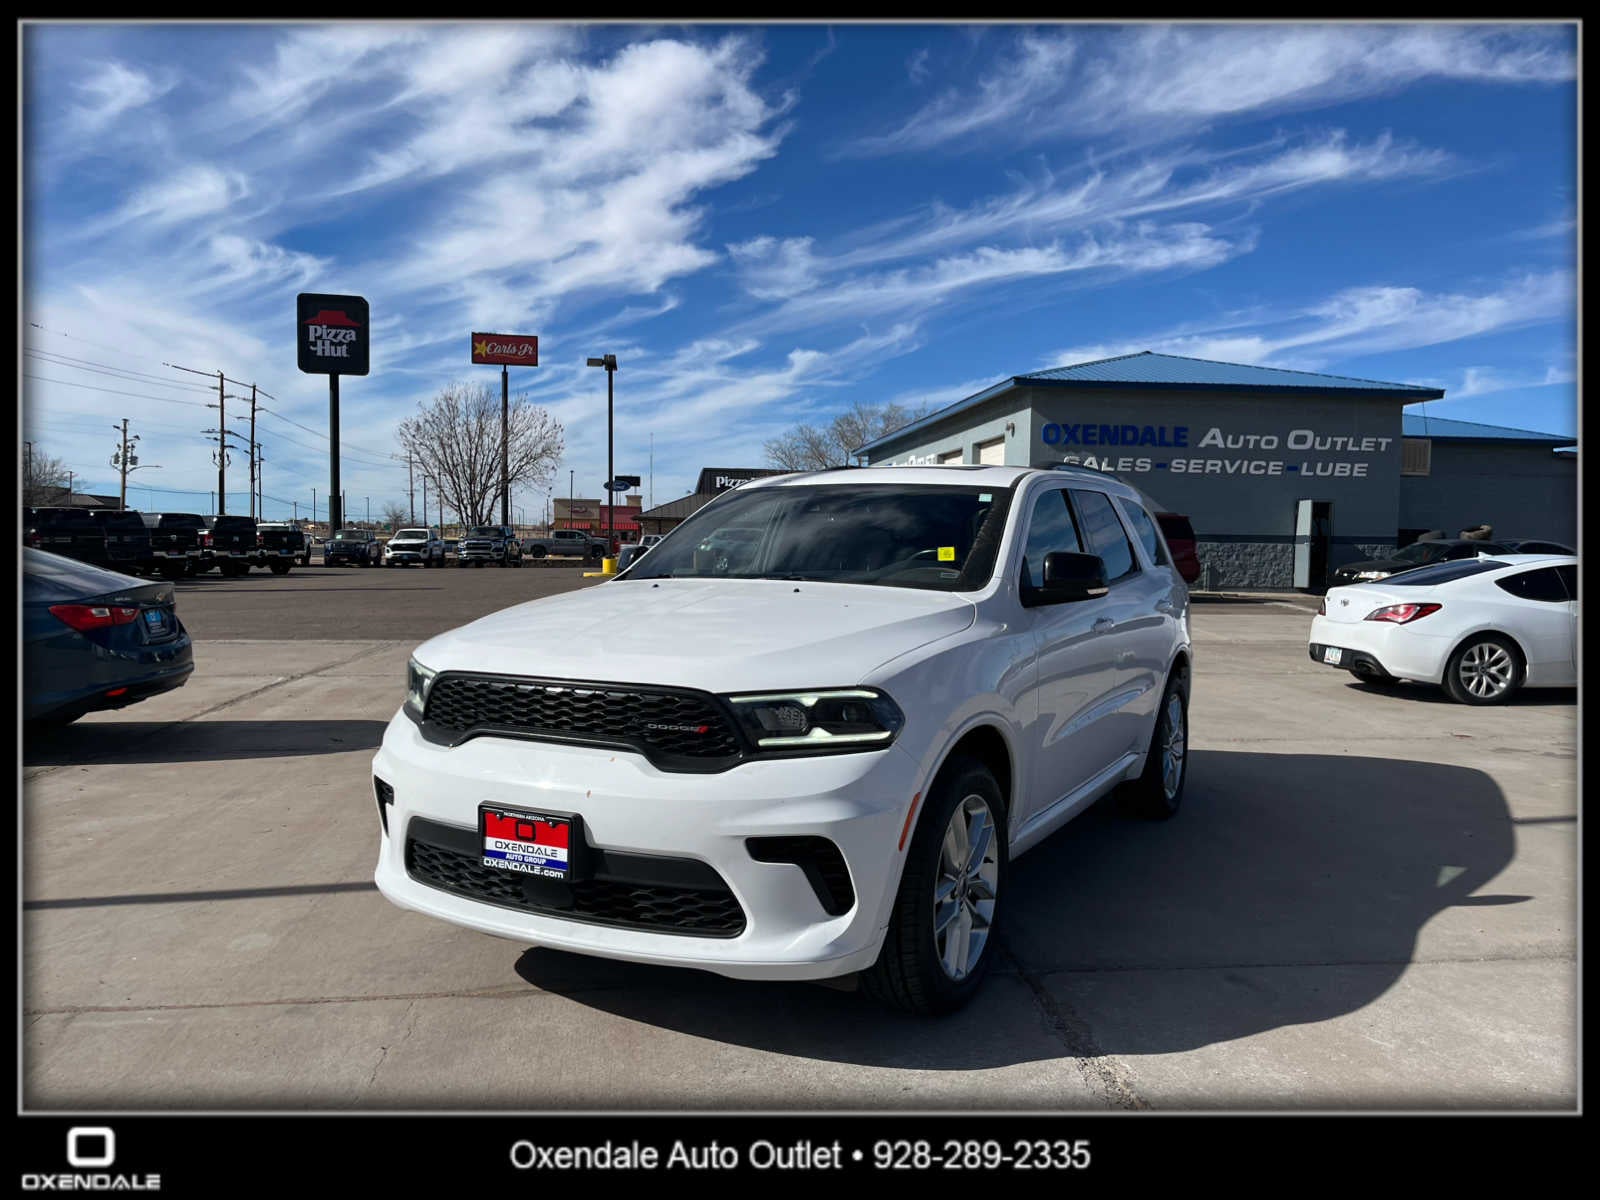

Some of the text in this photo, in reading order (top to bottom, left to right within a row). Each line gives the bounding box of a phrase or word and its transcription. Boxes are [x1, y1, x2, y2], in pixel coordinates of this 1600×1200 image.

[308, 324, 356, 343] Pizza
[309, 339, 350, 357] Hut
[1041, 422, 1189, 448] OXENDALE
[495, 840, 558, 858] OXENDALE
[505, 852, 547, 865] AUTO GROUP
[483, 858, 564, 879] OXENDALE.com
